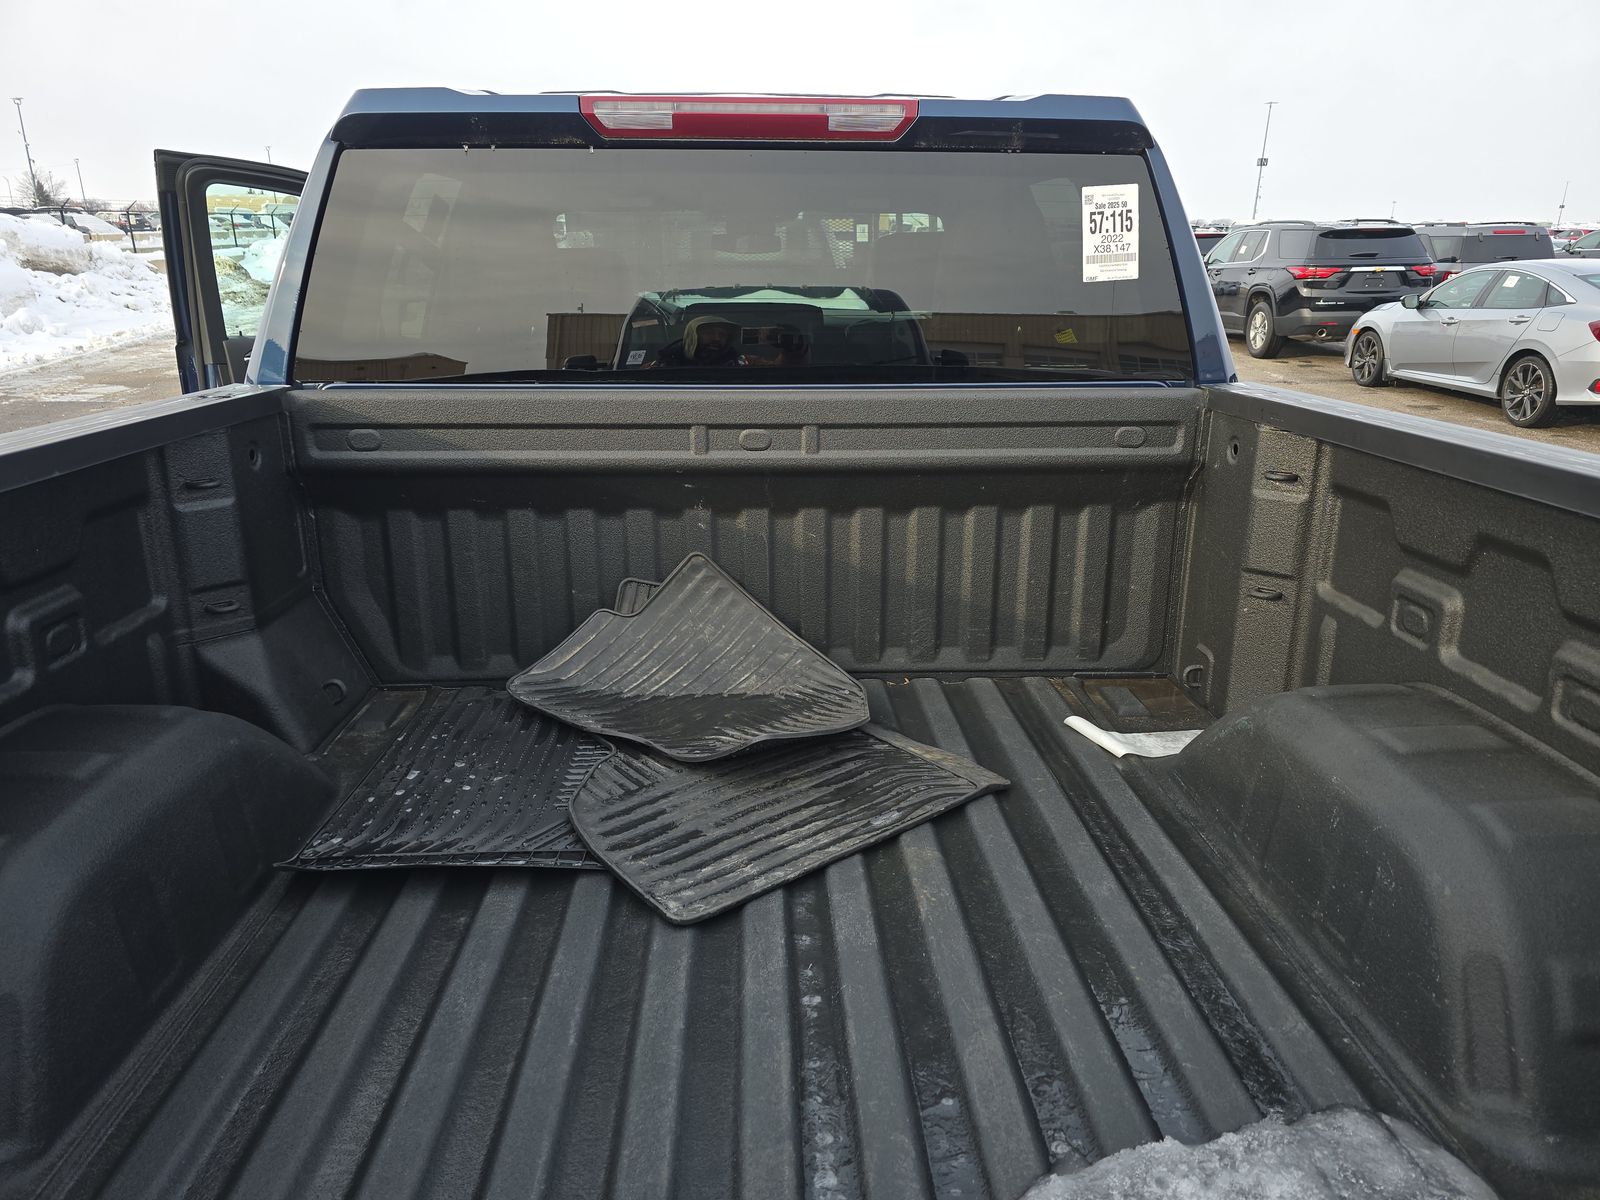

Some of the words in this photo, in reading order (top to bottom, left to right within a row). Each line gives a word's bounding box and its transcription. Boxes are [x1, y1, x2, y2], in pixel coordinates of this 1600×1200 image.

[1107, 201, 1120, 209] 2025
[1089, 209, 1133, 234] 57:115
[1100, 234, 1124, 243] 2022
